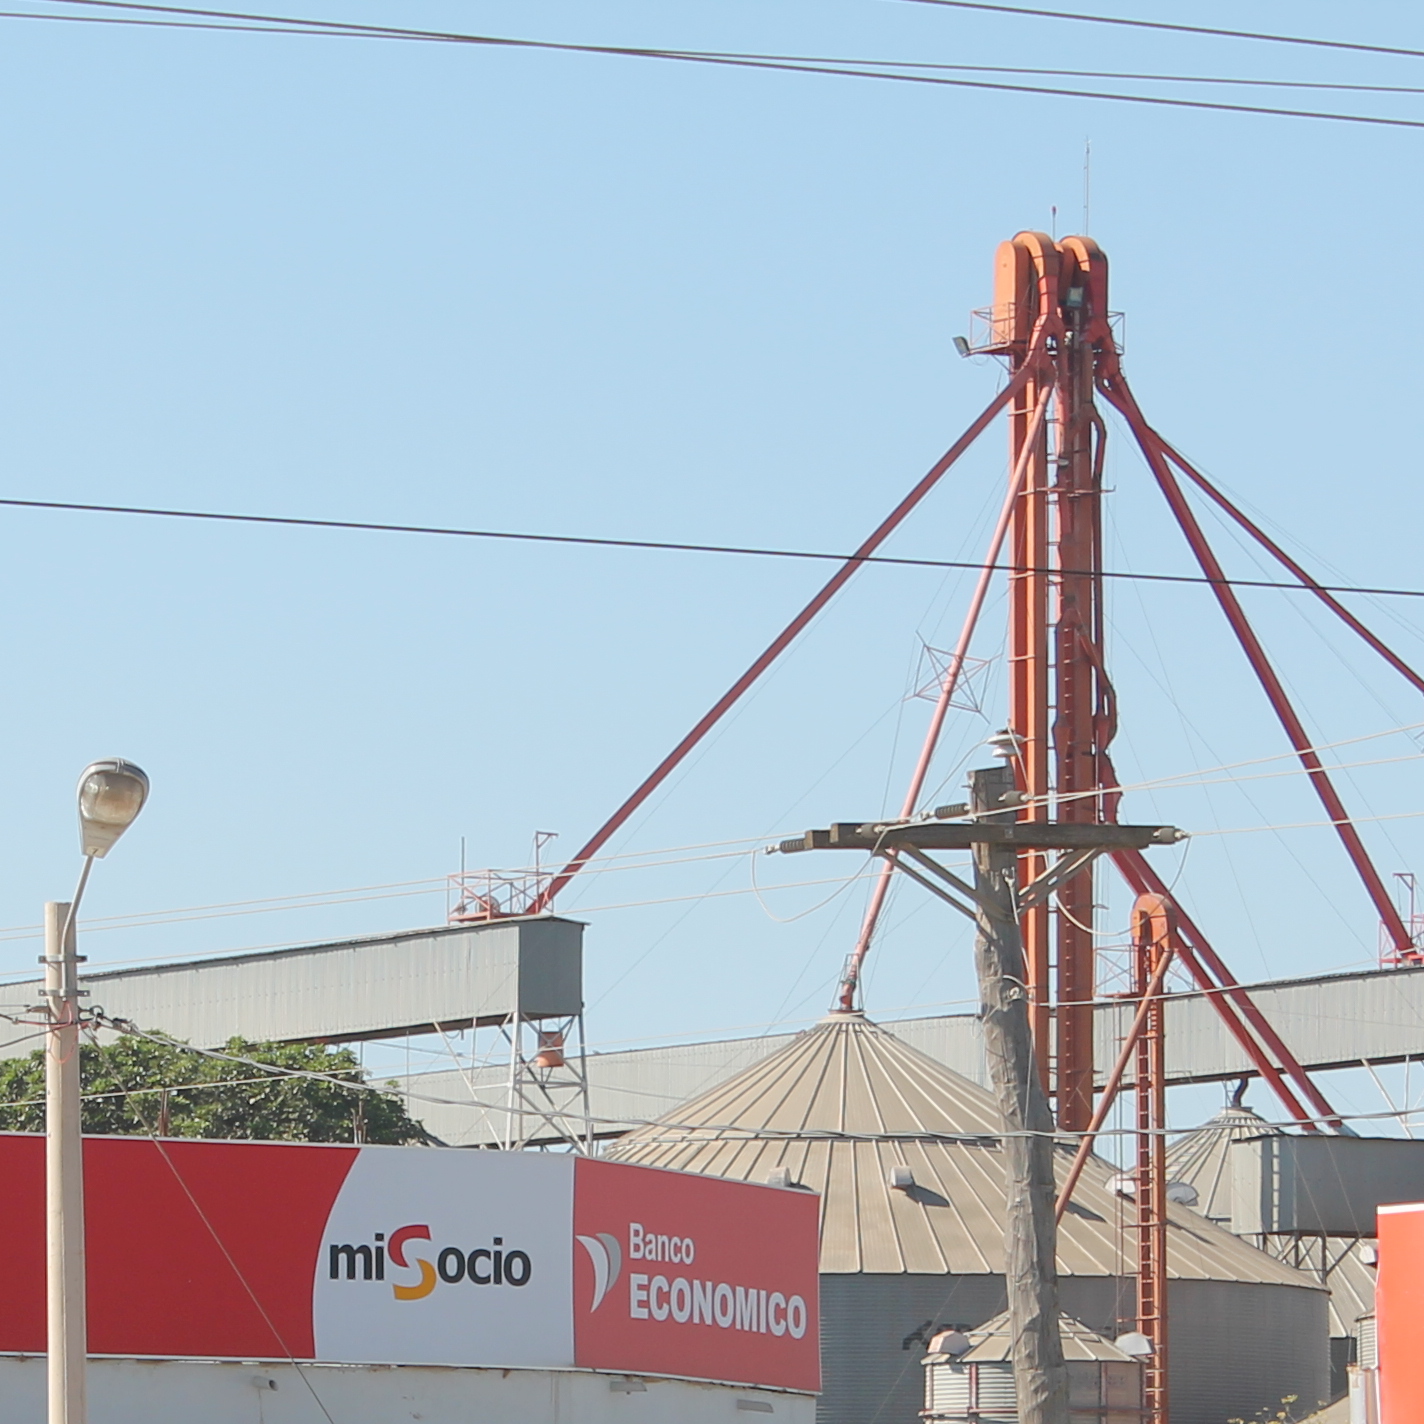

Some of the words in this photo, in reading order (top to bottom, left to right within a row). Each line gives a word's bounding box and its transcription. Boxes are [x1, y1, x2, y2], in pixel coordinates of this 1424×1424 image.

[328, 1223, 532, 1301] miSocio
[629, 1222, 694, 1265] Banco
[629, 1274, 807, 1340] ECONOMICO
